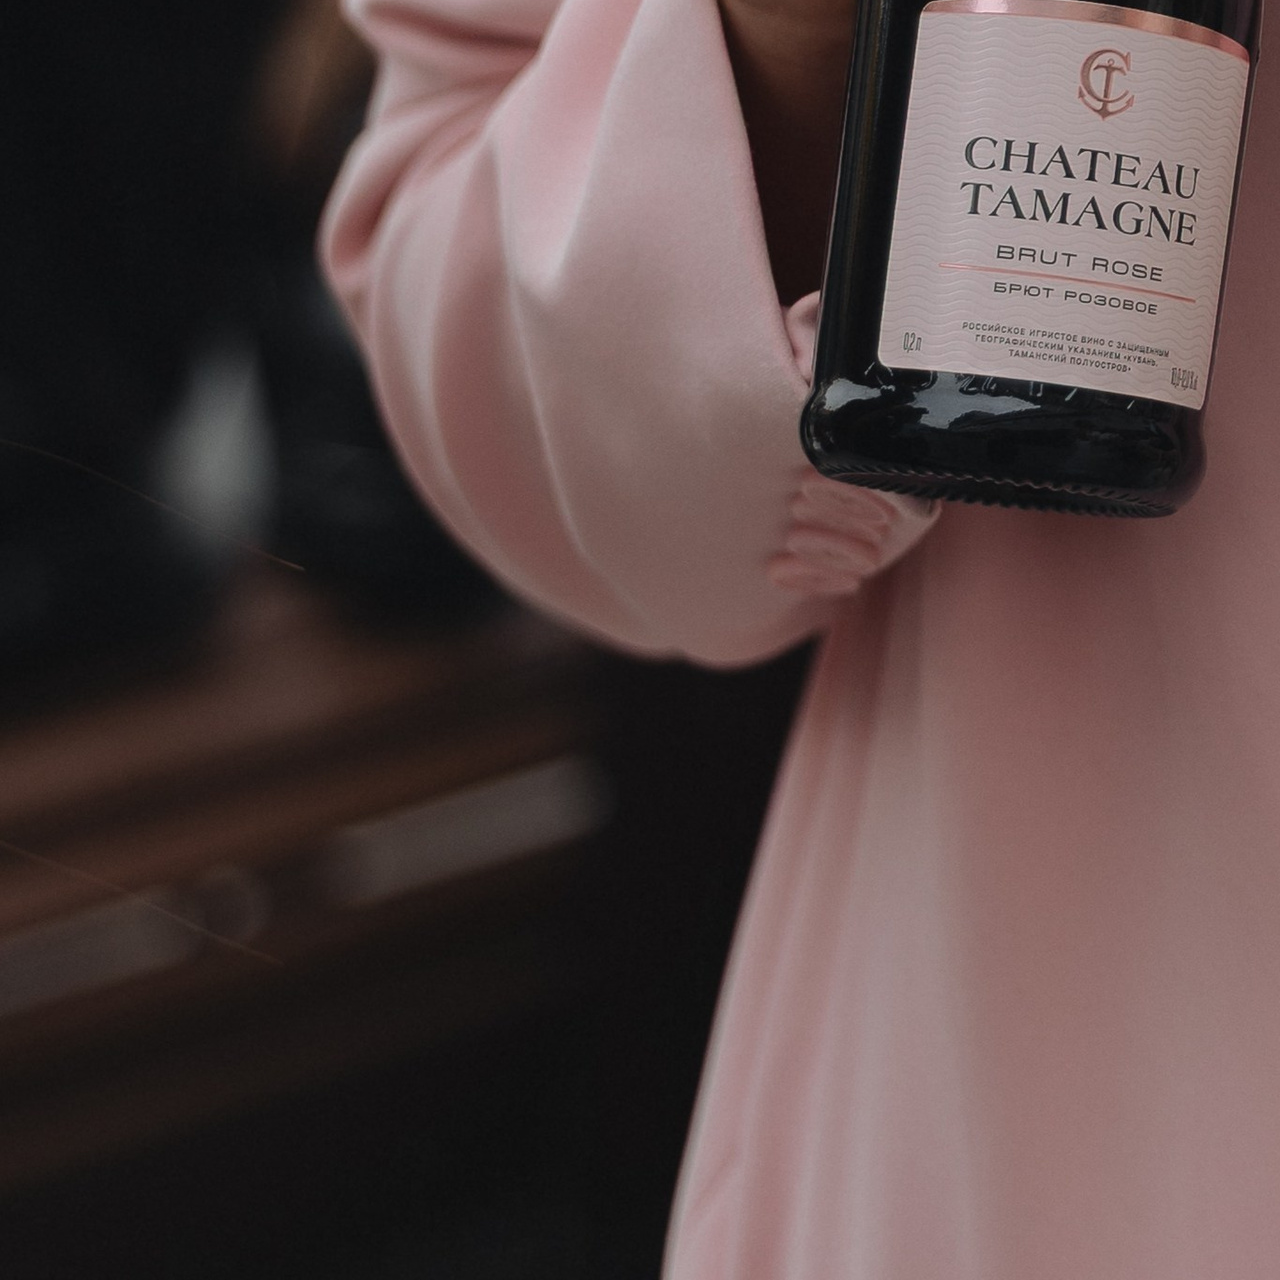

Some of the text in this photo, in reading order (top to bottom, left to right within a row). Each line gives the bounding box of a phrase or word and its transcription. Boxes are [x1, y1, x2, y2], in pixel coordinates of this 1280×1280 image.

[964, 136, 1200, 199] CHATEAU
[960, 181, 1198, 246] TAMAGNE
[996, 244, 1164, 282] BRUT ROSE
[993, 281, 1158, 315] БРЮТ РОЗОВОЕ
[962, 321, 1026, 336] РОССИЙСКОЕ
[1029, 328, 1078, 343] ИГРИСТОЕ
[1080, 335, 1106, 346] ВИНО
[1107, 339, 1114, 347] С
[975, 334, 1064, 351] ГЕОГРАФИЧЕСКИМ
[1067, 345, 1121, 360] УКАЗАНИЕМ
[1008, 348, 1067, 363] ТАМАНСКИЙ
